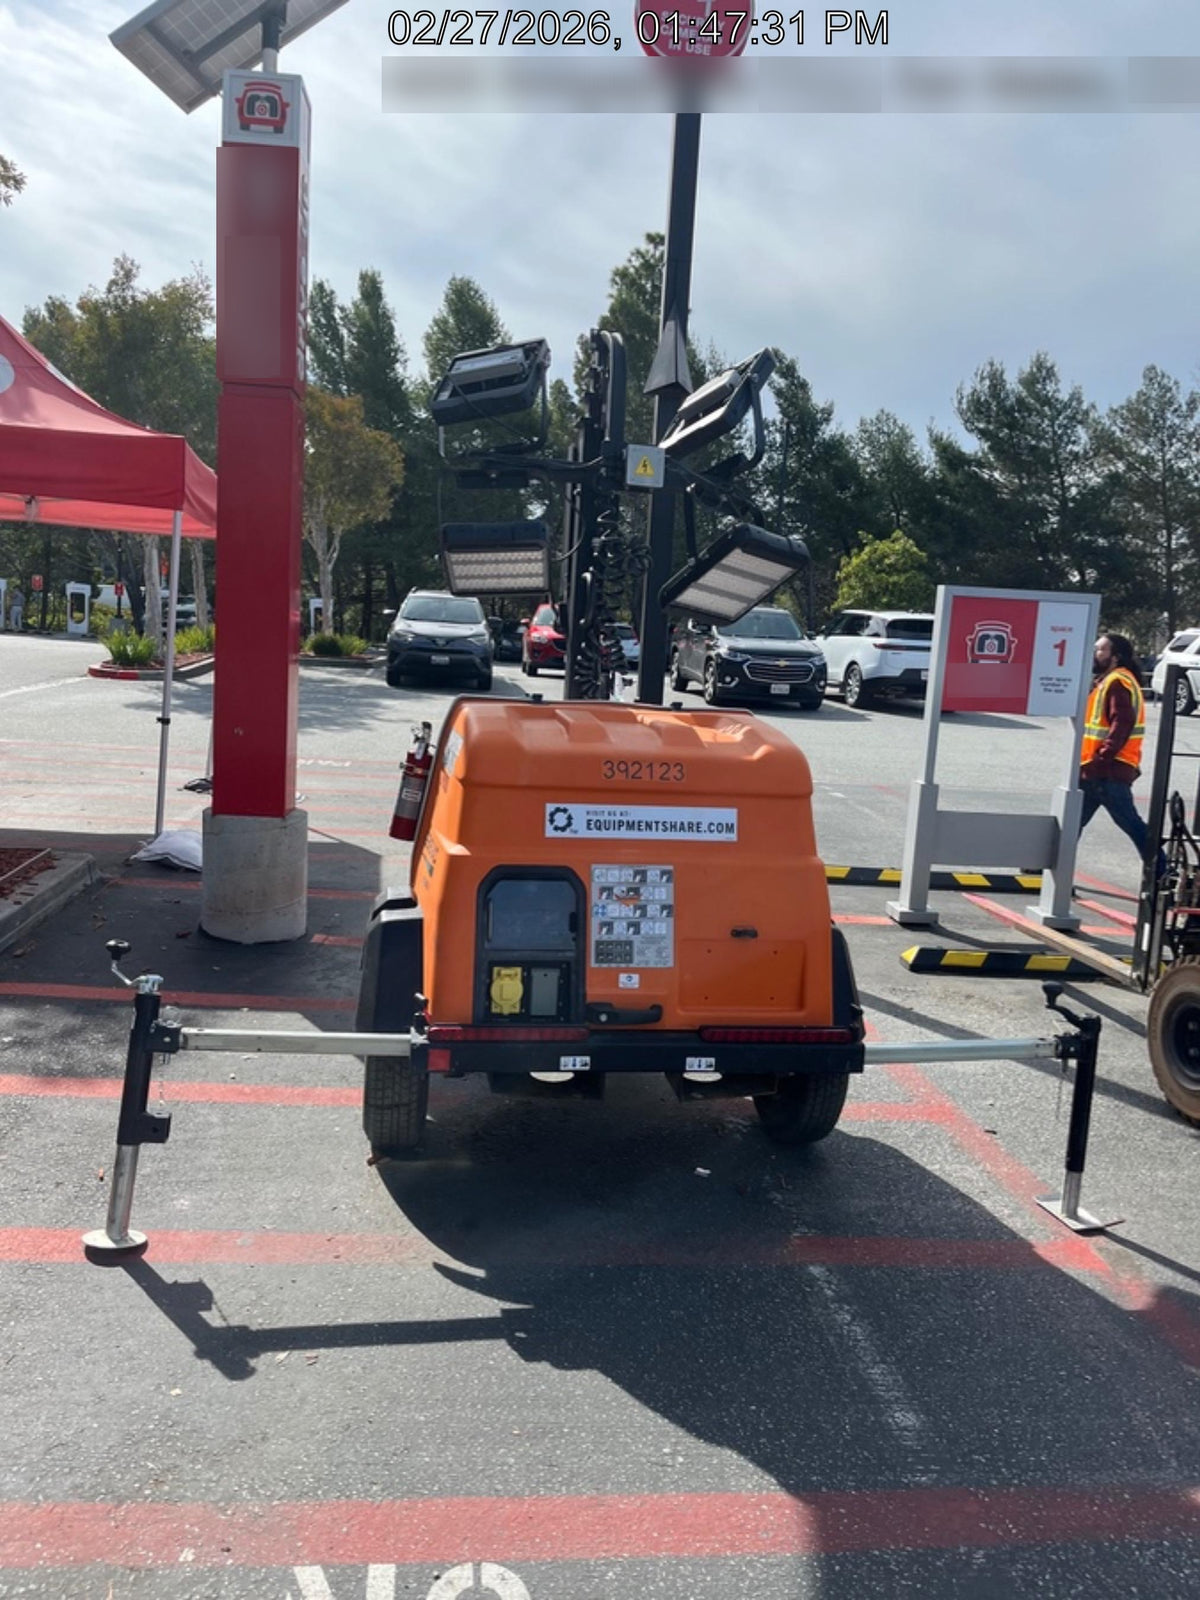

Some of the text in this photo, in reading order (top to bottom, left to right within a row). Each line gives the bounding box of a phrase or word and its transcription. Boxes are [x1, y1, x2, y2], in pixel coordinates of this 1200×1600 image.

[1053, 639, 1067, 666] 1
[603, 760, 685, 781] 392123
[586, 818, 735, 835] EQUIPMENTSHARE.COM
